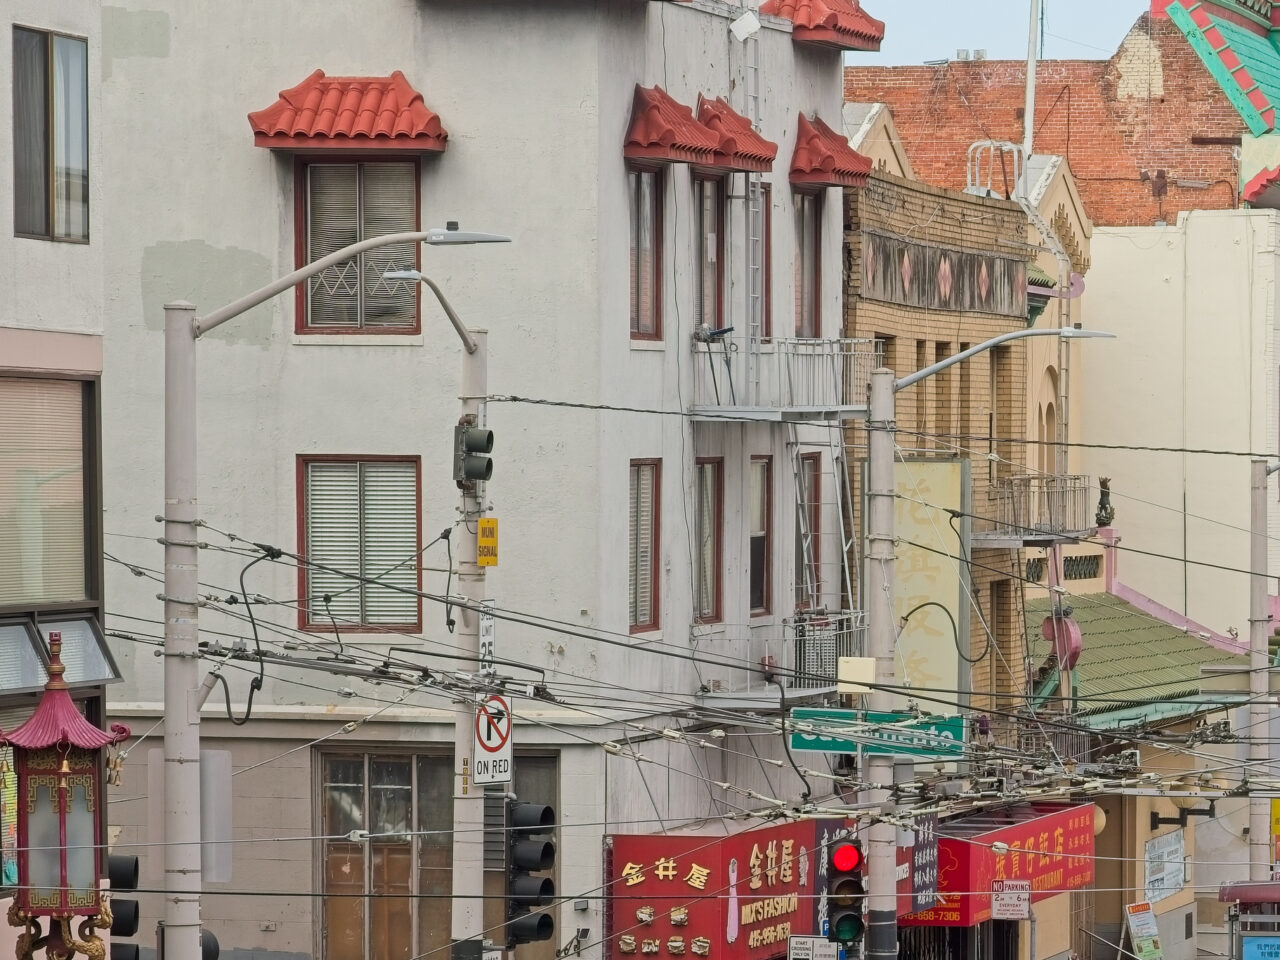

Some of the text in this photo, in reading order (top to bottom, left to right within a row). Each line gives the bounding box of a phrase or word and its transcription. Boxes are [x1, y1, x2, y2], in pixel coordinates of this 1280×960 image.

[481, 527, 495, 538] MUNI
[478, 545, 498, 557] SIGNAL
[480, 608, 494, 621] SPEED
[481, 624, 493, 637] LIMIT
[480, 641, 493, 669] 25
[476, 759, 509, 774] ON RED
[621, 857, 711, 890] 金井屋
[992, 881, 1029, 892] NO PARKING
[741, 891, 798, 925] MIX'S FASHION
